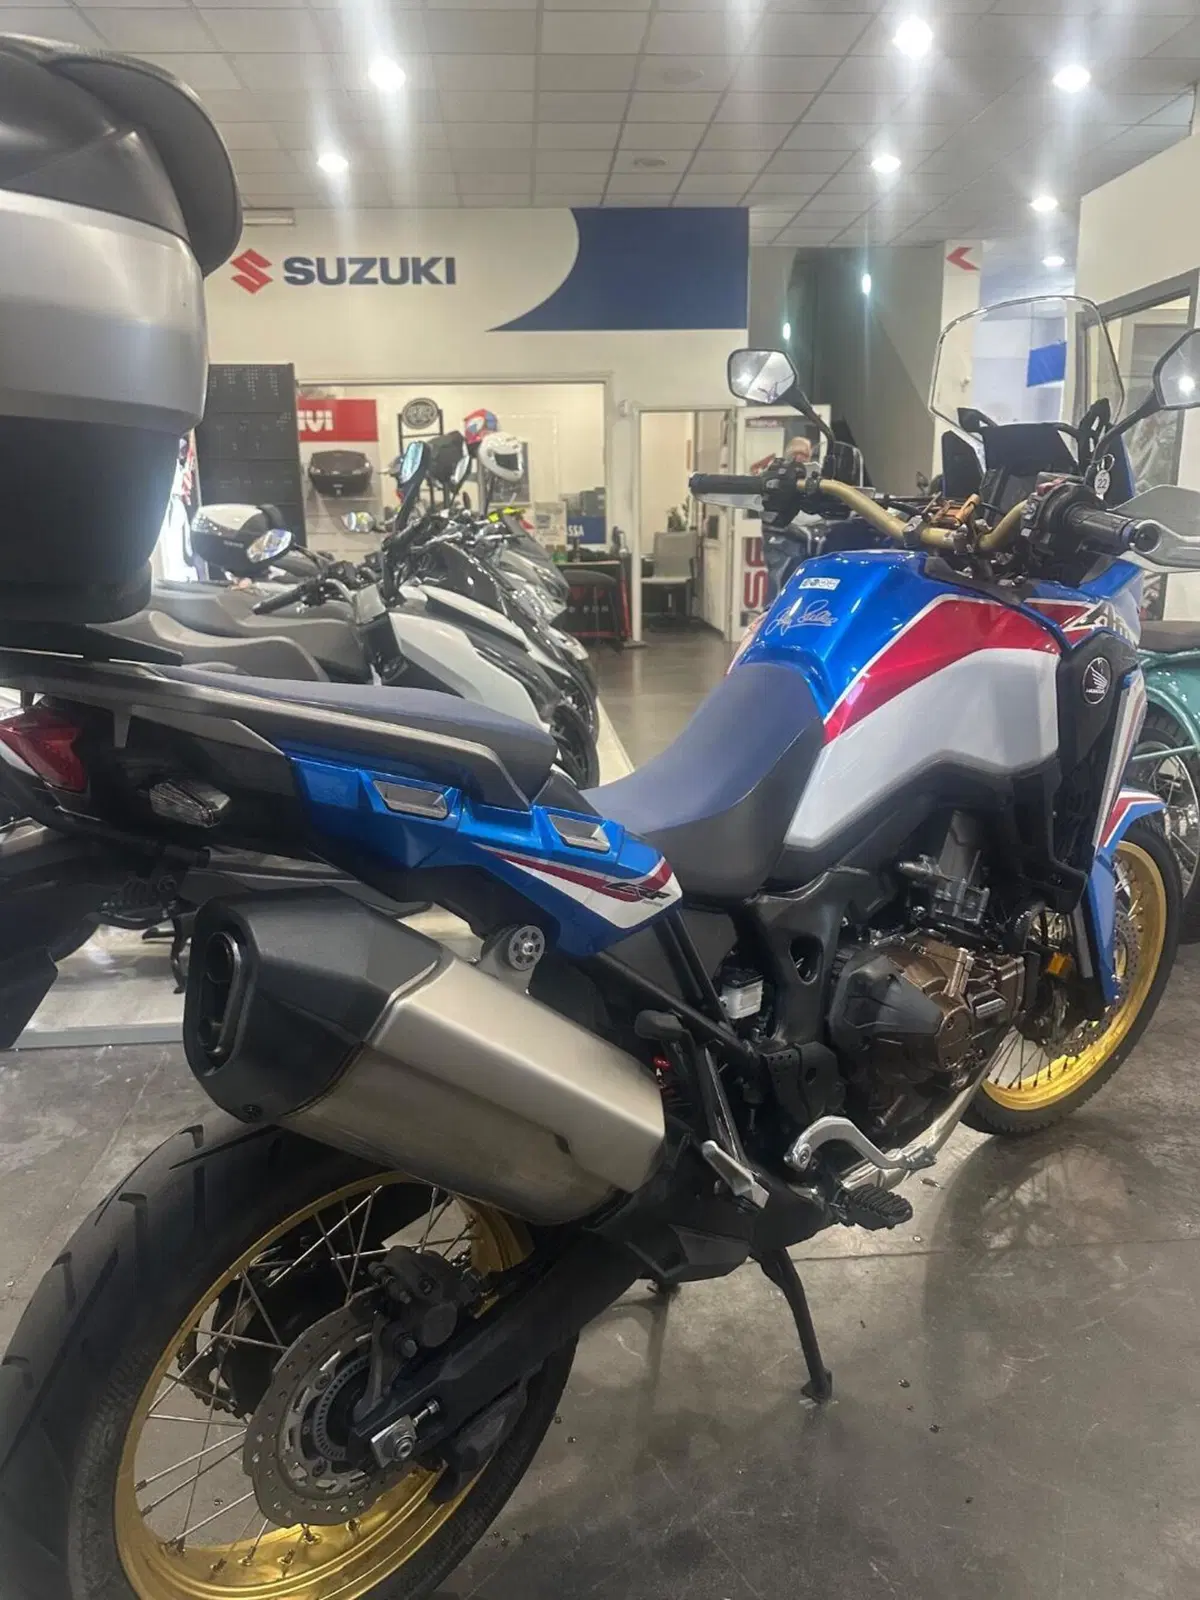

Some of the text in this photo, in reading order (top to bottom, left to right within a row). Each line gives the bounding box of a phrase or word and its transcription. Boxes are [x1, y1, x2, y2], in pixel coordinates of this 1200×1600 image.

[283, 256, 457, 286] SUZUKI
[297, 410, 334, 432] IVI
[565, 524, 585, 537] SSA
